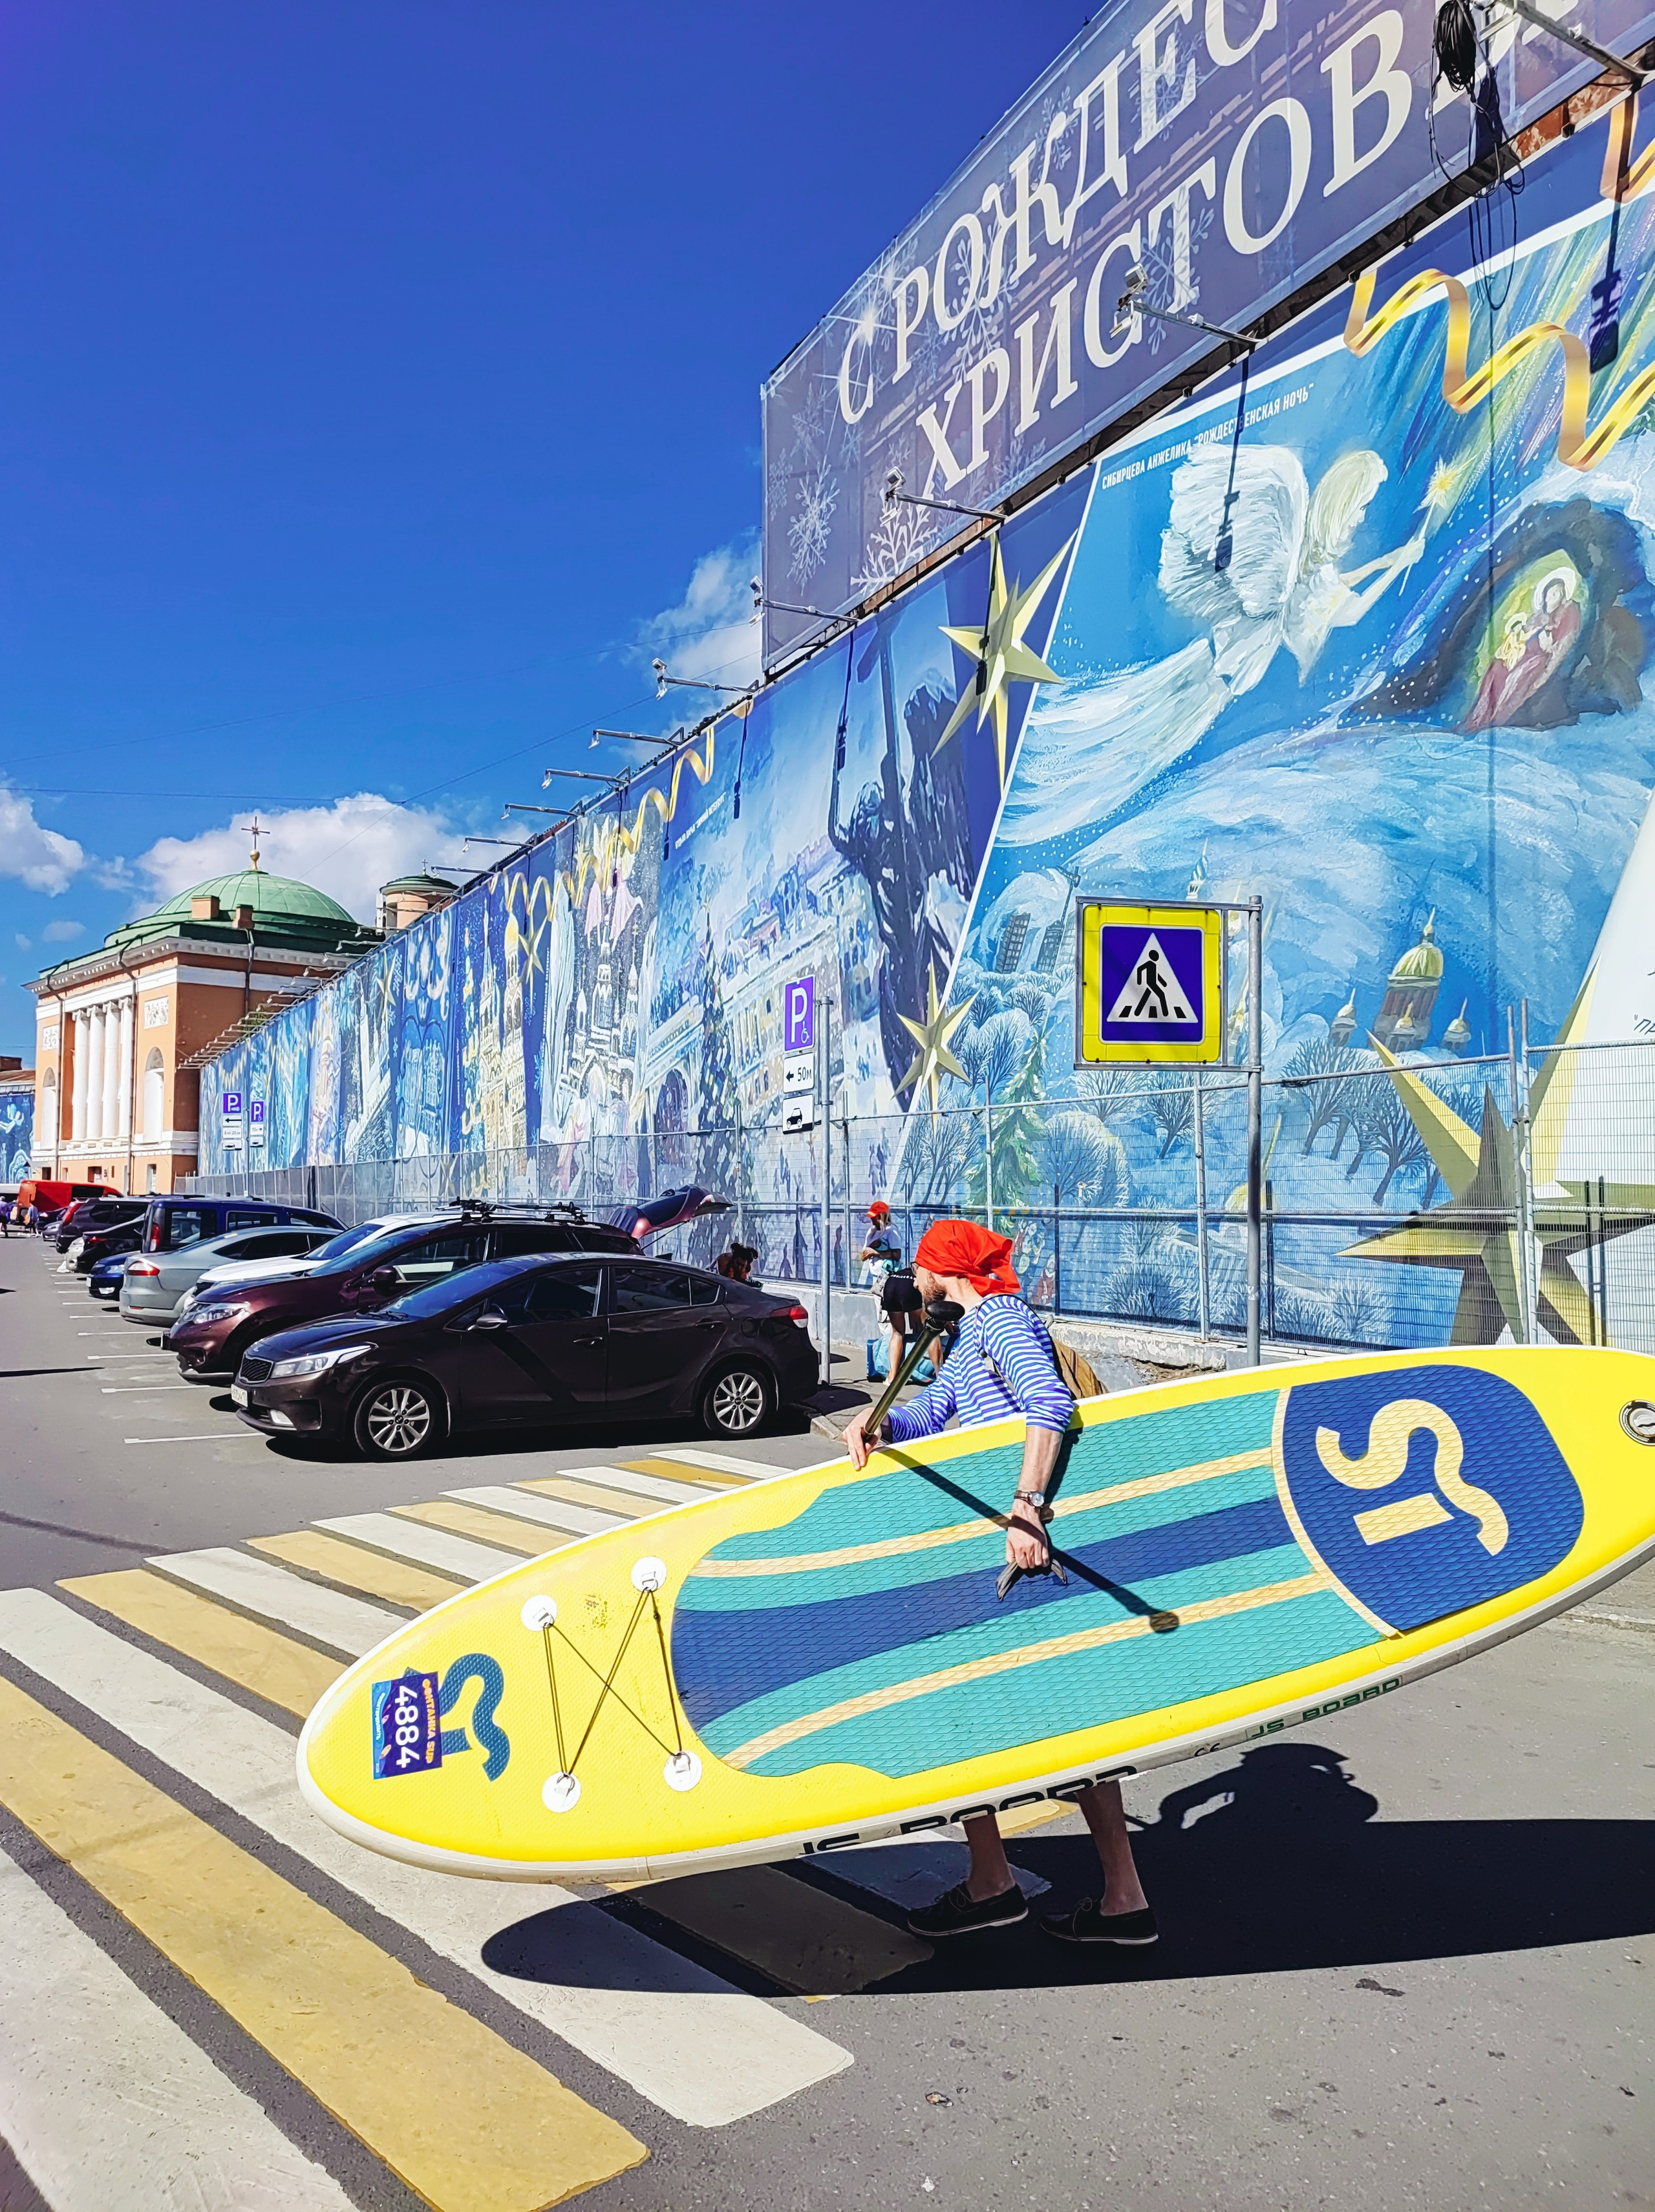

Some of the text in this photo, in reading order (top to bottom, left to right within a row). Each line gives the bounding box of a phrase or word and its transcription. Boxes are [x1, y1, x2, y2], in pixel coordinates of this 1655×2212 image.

[840, 324, 874, 424] С
[1102, 459, 1146, 490] СИБИРЦЕВА
[1147, 439, 1193, 471] АНЖЕЛИКА
[791, 986, 808, 1043] P
[228, 1095, 238, 1111] P
[253, 1103, 261, 1120] P
[395, 1685, 420, 1768] 4884
[425, 1741, 435, 1763] SUP
